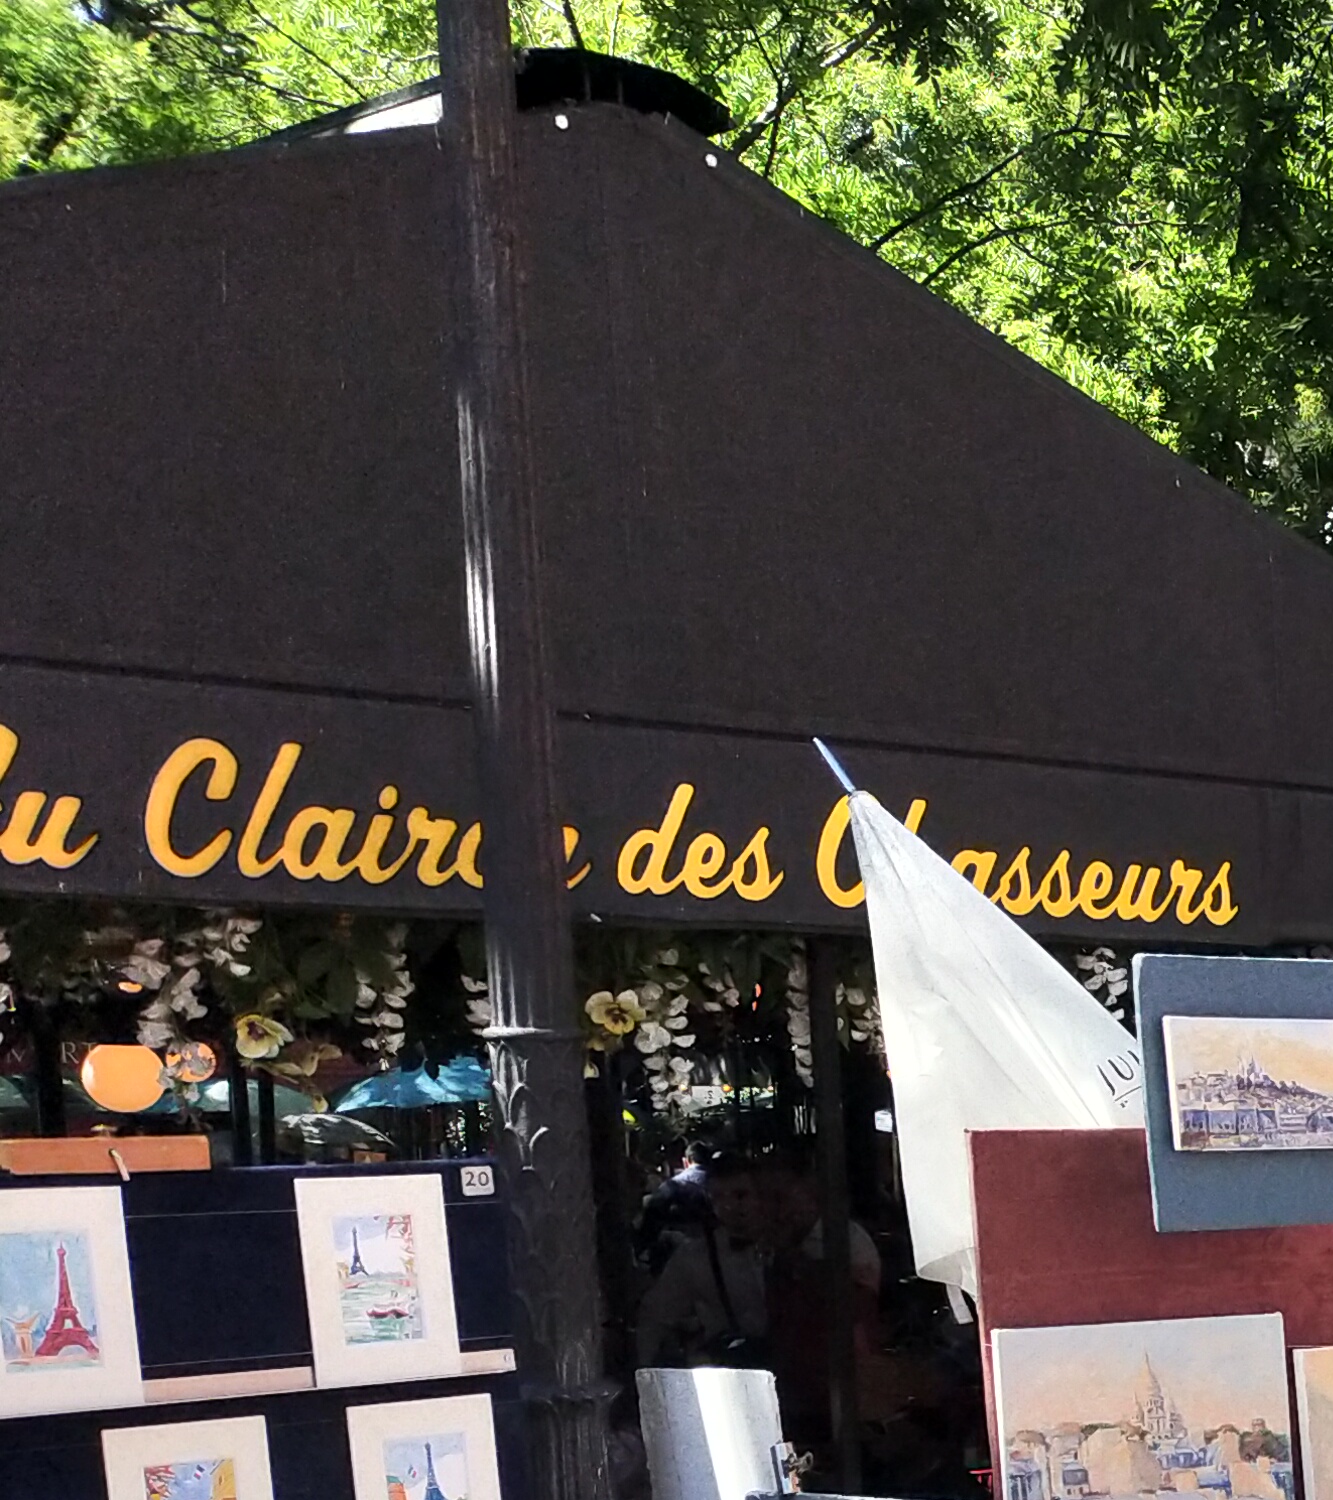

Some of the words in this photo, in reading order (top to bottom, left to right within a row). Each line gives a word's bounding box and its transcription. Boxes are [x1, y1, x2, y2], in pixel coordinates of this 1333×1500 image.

[617, 783, 784, 901] des
[816, 795, 1239, 926] Casseurs
[465, 1171, 490, 1187] 20
